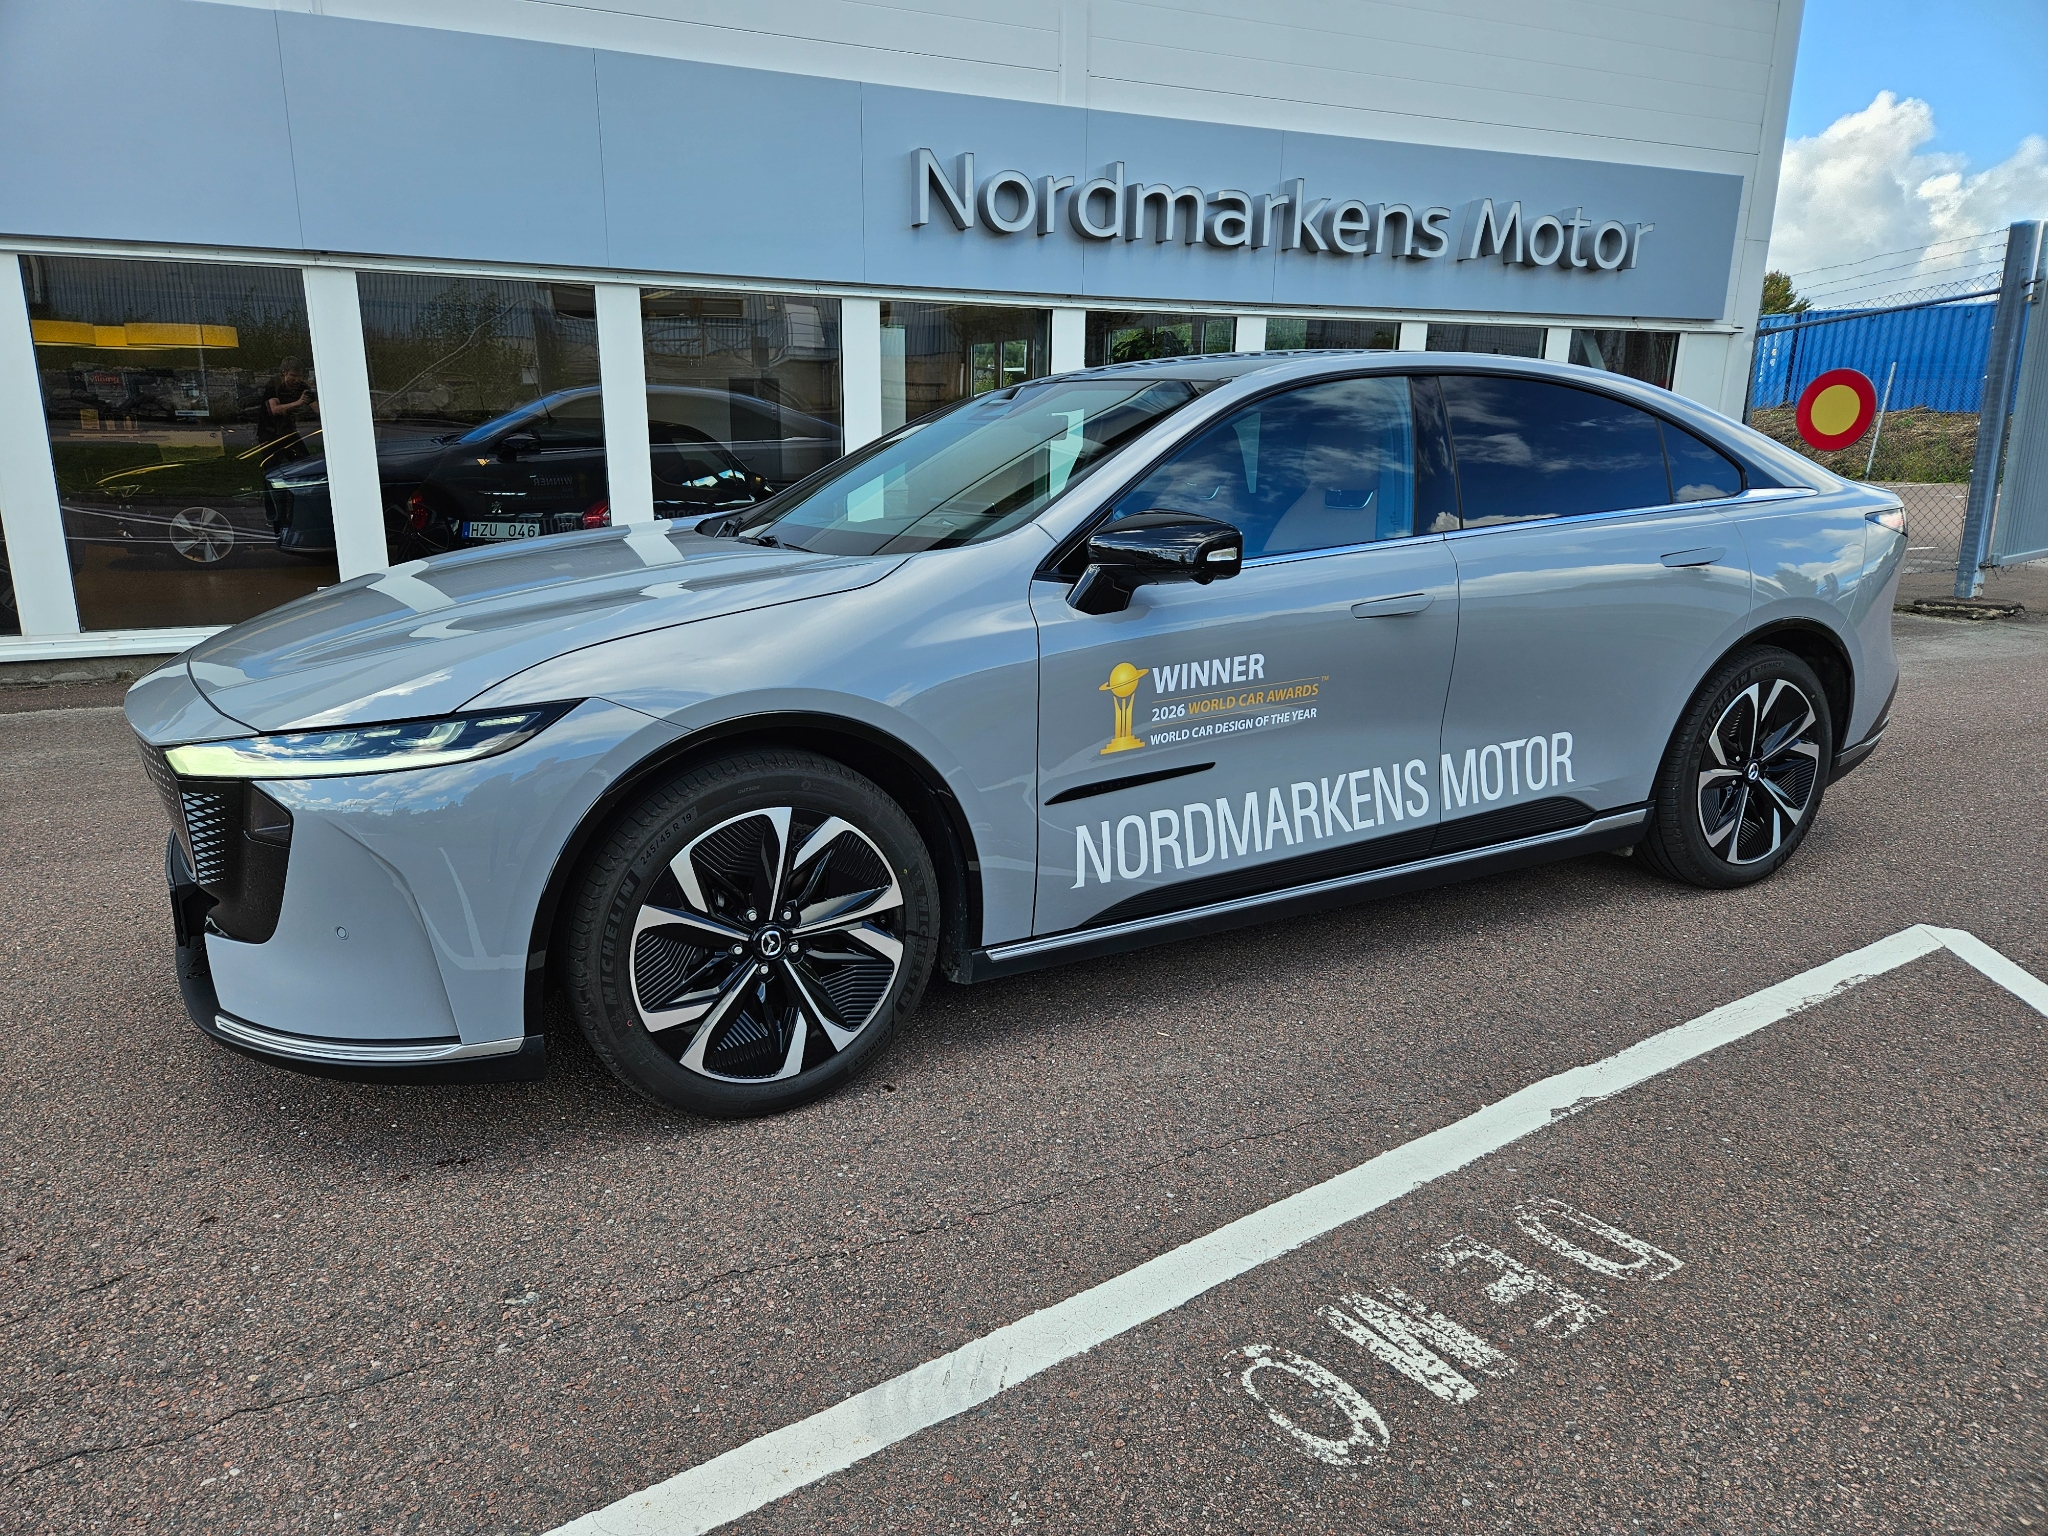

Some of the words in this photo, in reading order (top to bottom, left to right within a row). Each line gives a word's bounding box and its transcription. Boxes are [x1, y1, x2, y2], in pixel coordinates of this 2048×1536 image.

[911, 147, 1451, 260] Nordmarkens
[1456, 197, 1655, 272] Motor
[471, 523, 498, 537] HZU
[508, 524, 536, 538] 046
[1152, 653, 1265, 694] WINNER
[1150, 729, 1190, 746] WORLD
[1191, 725, 1213, 738] CAR
[1214, 718, 1253, 734] DESIGN
[1255, 715, 1269, 728] OF
[1271, 712, 1290, 726] THE
[1291, 707, 1317, 722] YEAR
[1151, 704, 1186, 722] 2026
[1188, 696, 1236, 715] WORLD
[1238, 691, 1264, 707] CAR
[1266, 683, 1320, 703] AWARDS
[1701, 672, 1749, 739] MICHELIN
[737, 785, 761, 794] OUTSIDE
[1070, 759, 1430, 890] NORDMARKENS
[1441, 731, 1576, 810] MOTOR
[640, 829, 671, 865] 245/45
[673, 823, 681, 833] R
[682, 813, 692, 824] 19
[602, 876, 636, 1005] MICHELIN
[899, 897, 929, 1010] MICHELIN
